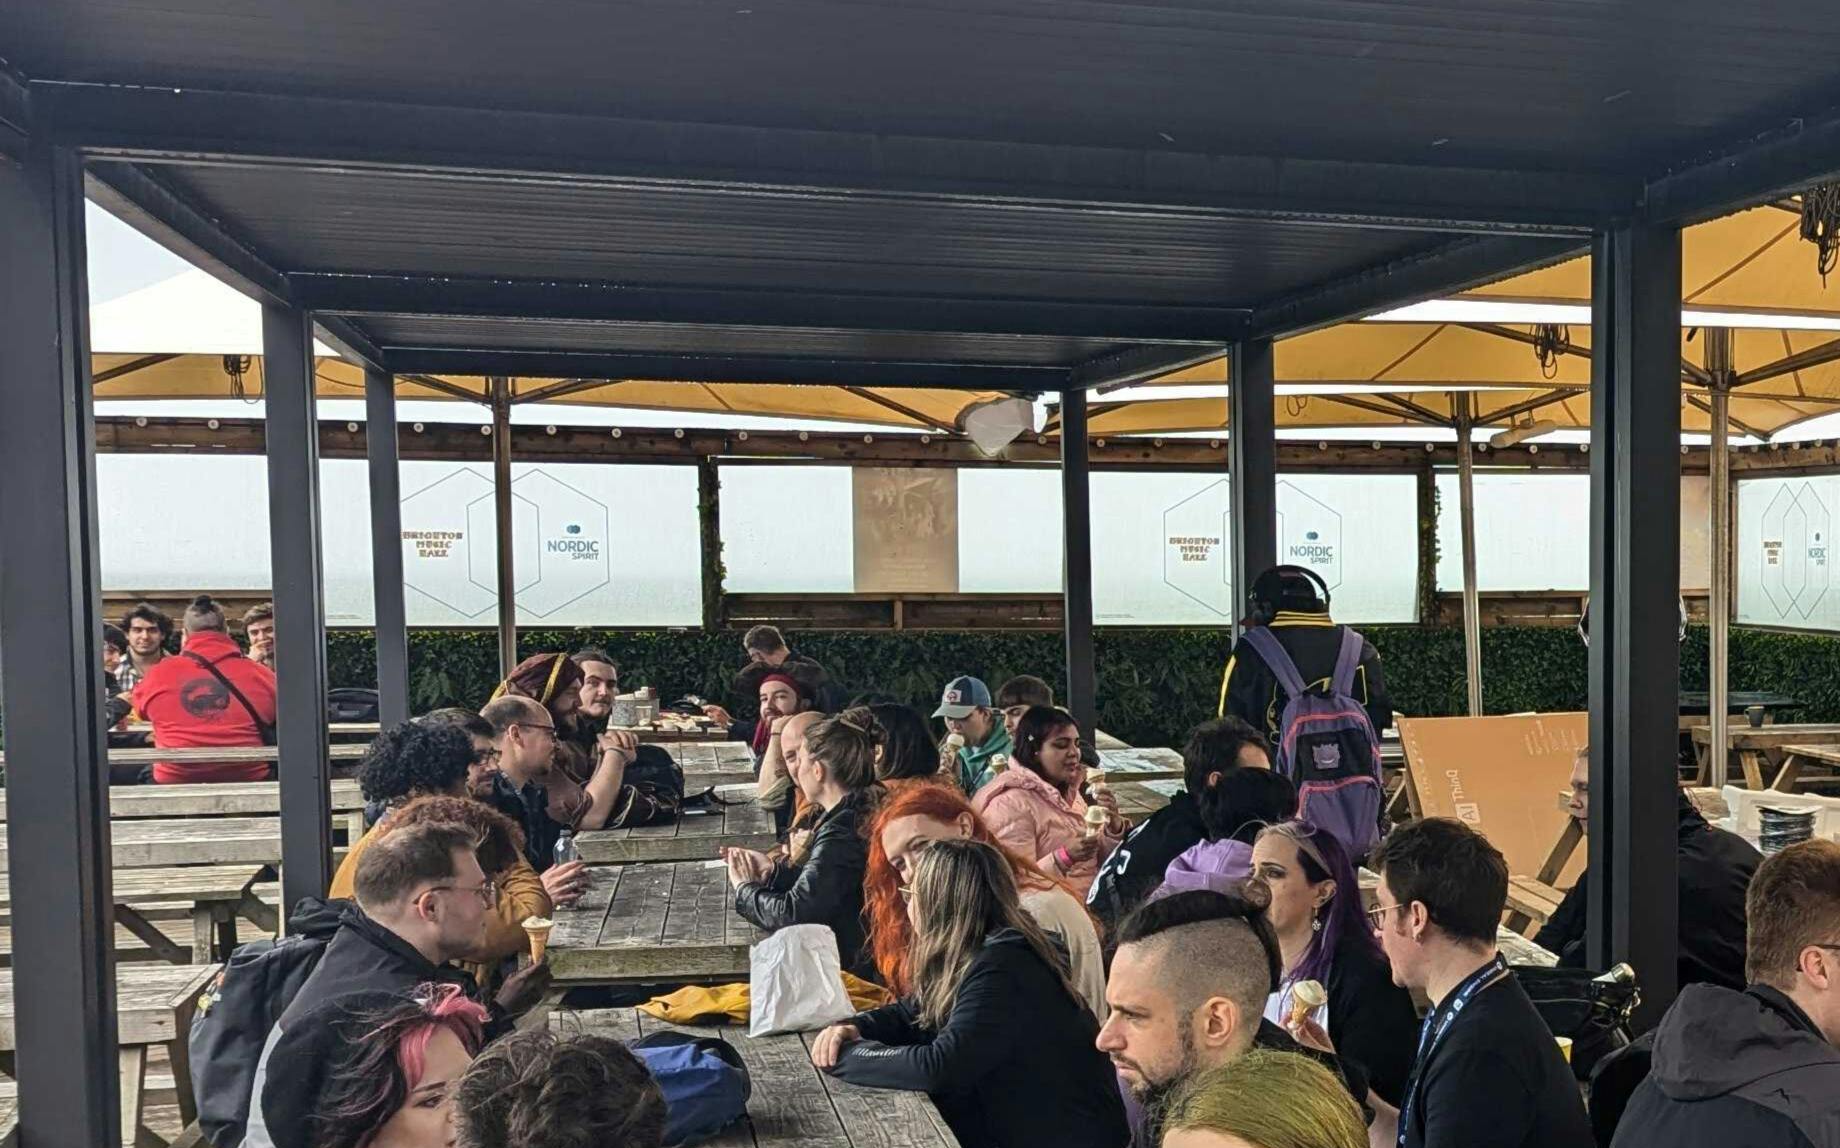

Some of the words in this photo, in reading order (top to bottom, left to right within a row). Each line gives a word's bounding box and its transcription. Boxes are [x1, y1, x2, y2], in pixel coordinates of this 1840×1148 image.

[416, 541, 452, 549] MUSIC
[547, 540, 599, 553] NORDIC
[572, 553, 599, 561] SPIRIT
[1290, 546, 1333, 557] NORDIC
[1446, 769, 1464, 803] ThinQ
